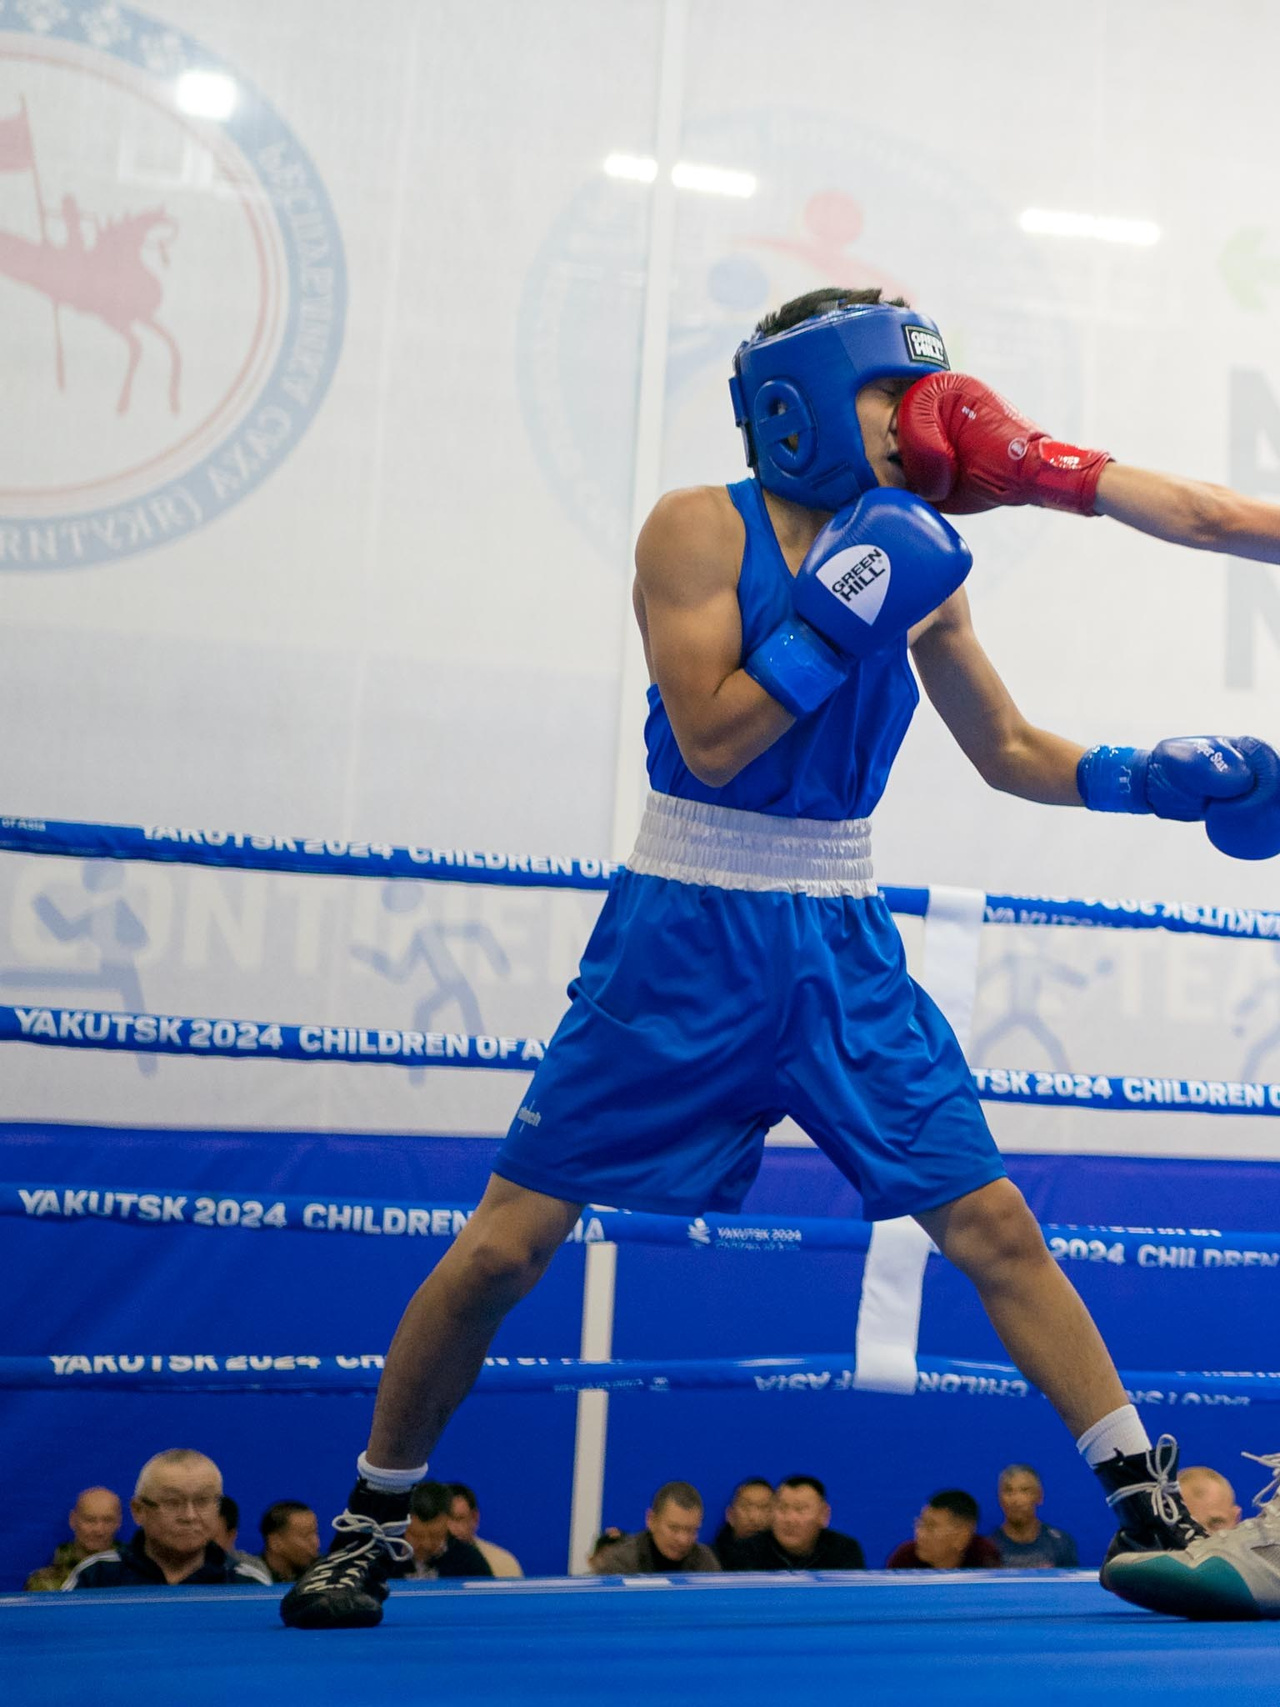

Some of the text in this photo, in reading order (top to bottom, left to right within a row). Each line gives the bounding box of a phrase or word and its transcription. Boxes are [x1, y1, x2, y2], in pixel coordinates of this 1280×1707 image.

[832, 548, 882, 593] GREEN
[840, 566, 886, 602] HILL
[408, 845, 573, 876] CHILDREN
[15, 1007, 182, 1047] YAKUTSK
[189, 1019, 282, 1050] 2024
[299, 1025, 470, 1058] CHILDREN
[475, 1036, 517, 1060] OF
[1034, 1072, 1112, 1099] 2024
[1122, 1076, 1264, 1108] CHILDREN
[17, 1189, 187, 1223] YAKUTSK
[193, 1197, 287, 1229] 2024
[1049, 1236, 1126, 1266] 2024
